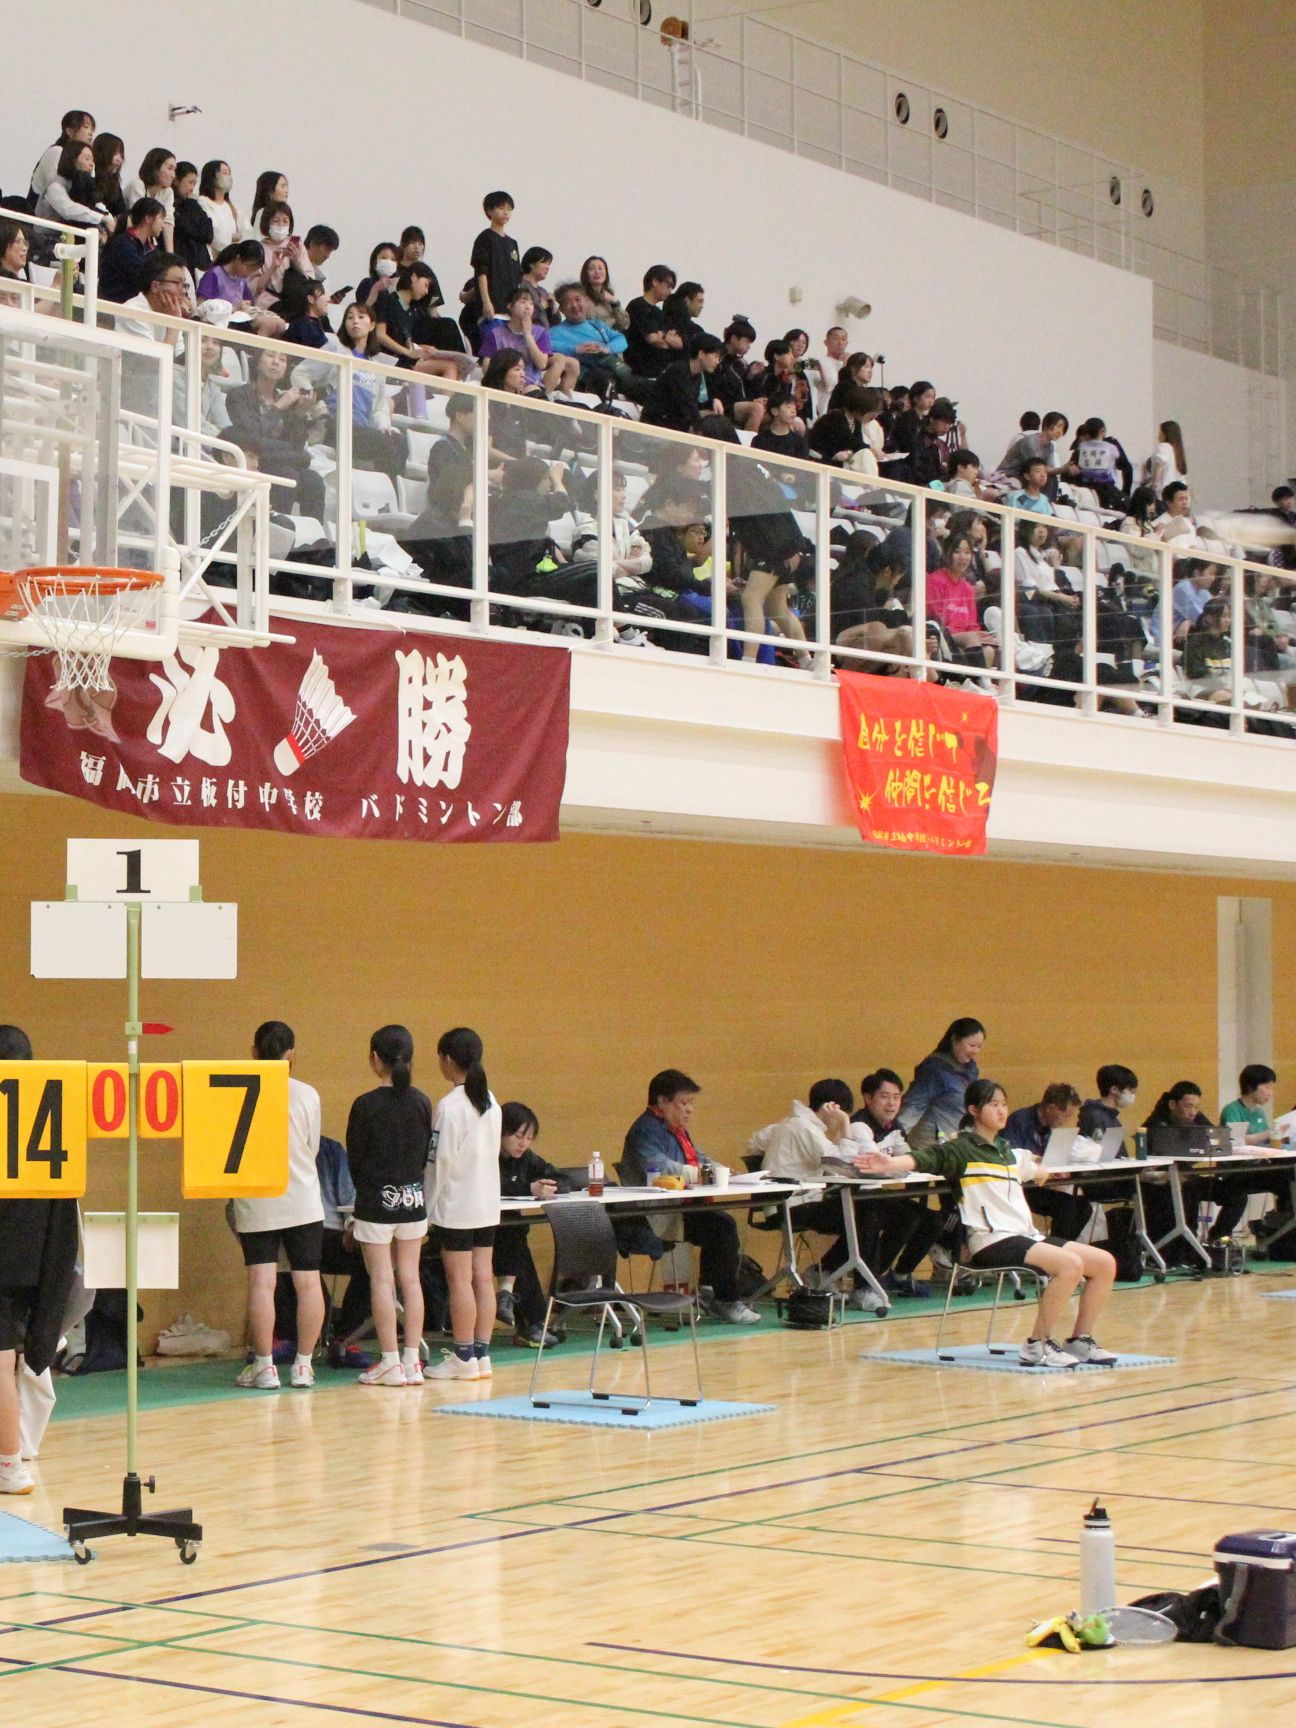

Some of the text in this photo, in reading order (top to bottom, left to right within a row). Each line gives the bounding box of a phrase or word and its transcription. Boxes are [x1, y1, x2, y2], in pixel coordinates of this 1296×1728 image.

[116, 849, 151, 893] 1
[91, 1069, 126, 1132] 0
[144, 1069, 179, 1132] 0
[209, 1073, 261, 1174] 7
